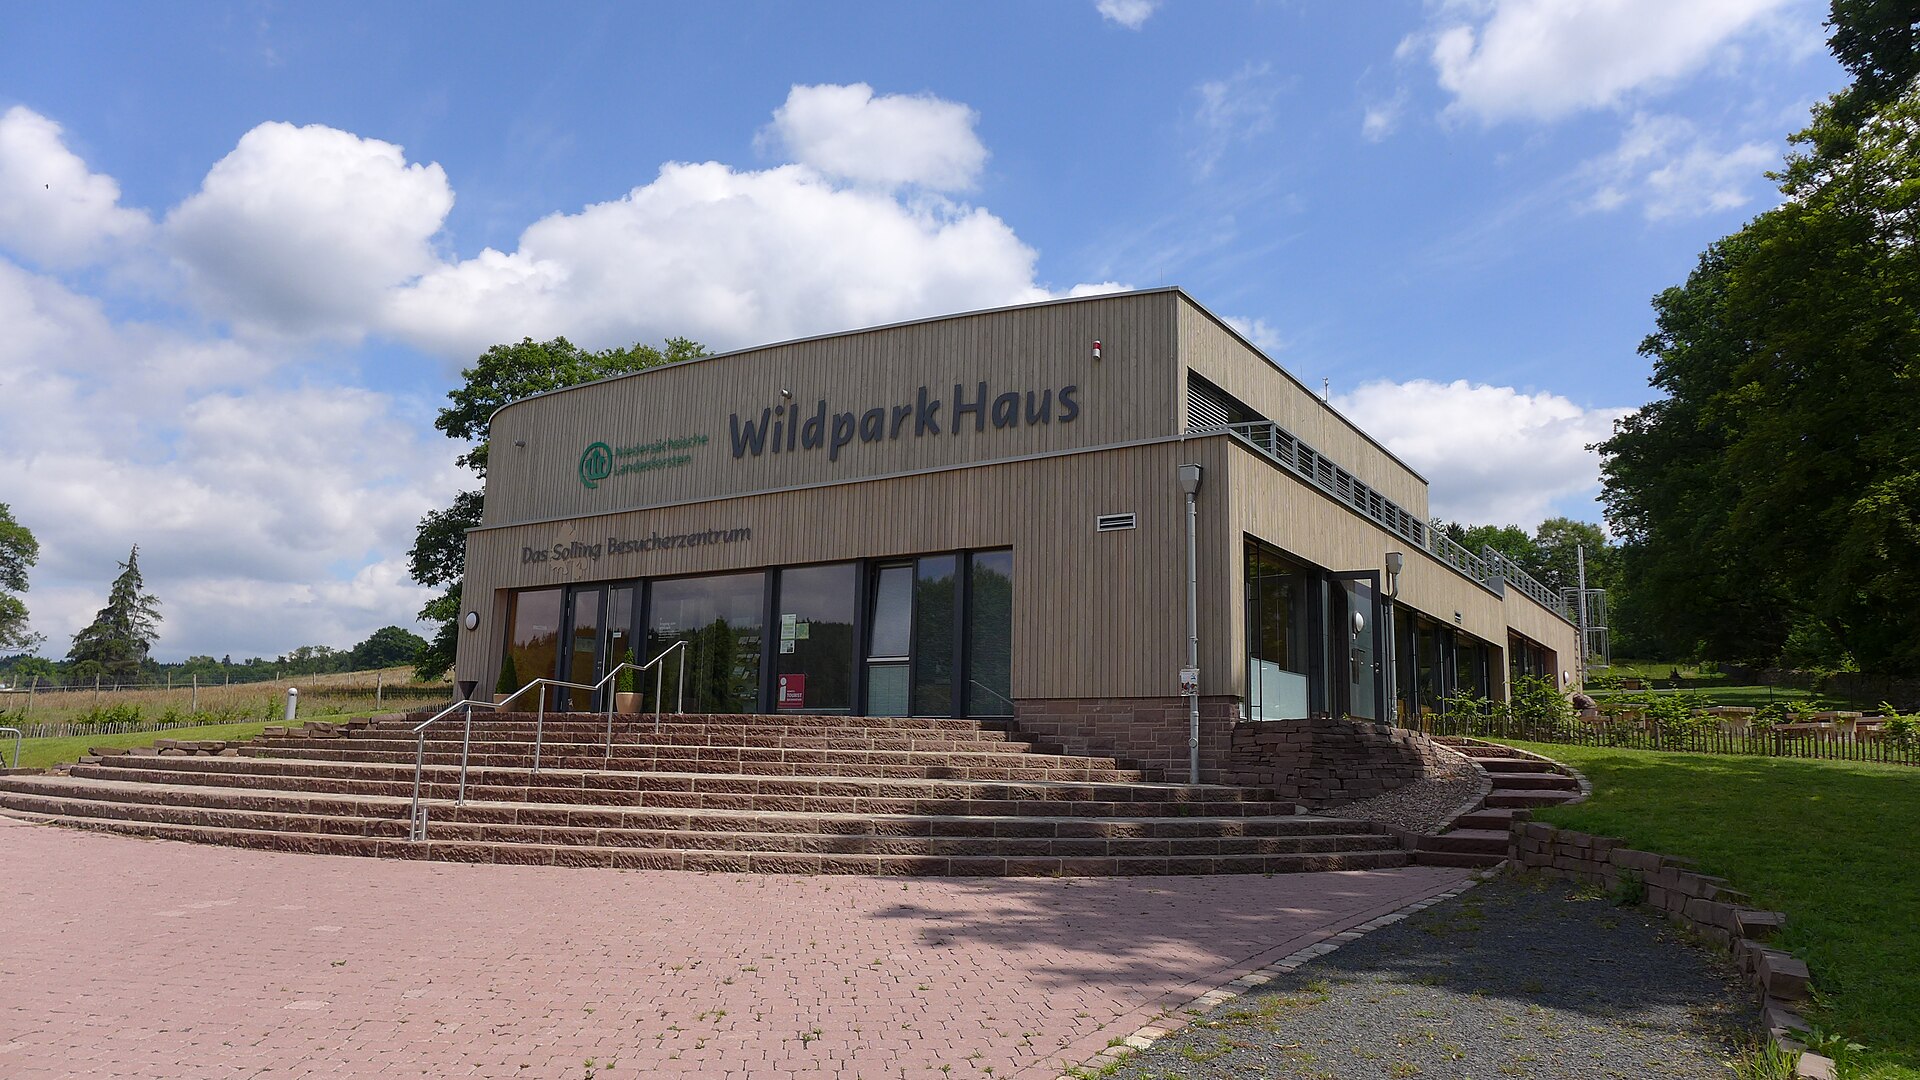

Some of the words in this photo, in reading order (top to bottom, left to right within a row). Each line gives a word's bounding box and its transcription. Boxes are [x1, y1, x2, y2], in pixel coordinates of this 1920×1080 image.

[615, 433, 709, 458] Niedersächsische
[614, 454, 692, 476] Landesforsten
[521, 546, 549, 565] Das
[552, 541, 602, 562] Solling
[607, 526, 752, 555] Besucherzentrum
